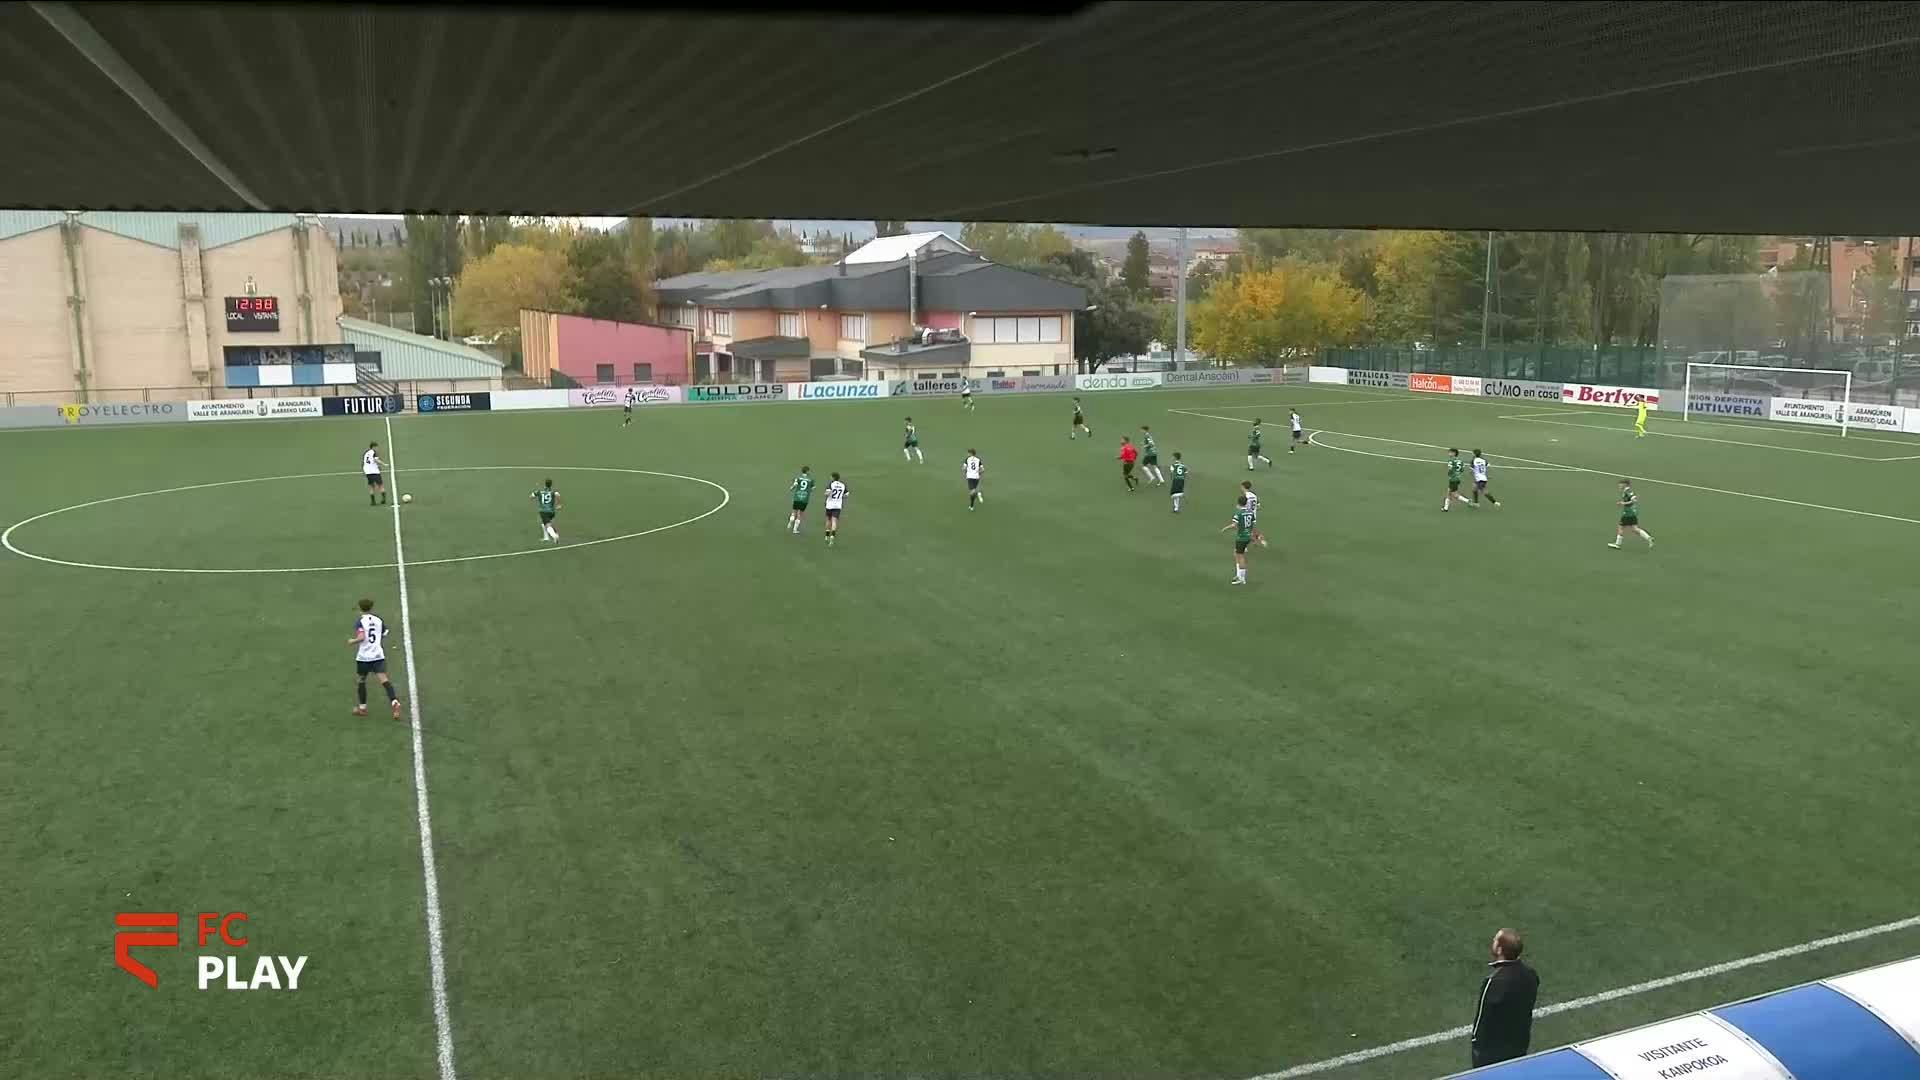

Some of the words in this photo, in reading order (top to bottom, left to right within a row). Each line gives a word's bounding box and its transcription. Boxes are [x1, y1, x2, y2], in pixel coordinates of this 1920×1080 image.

[234, 299, 273, 310] 12:38
[227, 312, 244, 320] LOCAL
[1348, 371, 1390, 379] METALICAS
[913, 380, 958, 391] talleres
[1083, 375, 1127, 389] denda
[1348, 378, 1389, 387] MUTILVA
[692, 384, 783, 396] TOLDOS
[801, 383, 878, 398] Lacunza
[1523, 388, 1535, 397] en
[1538, 389, 1559, 400] casa
[436, 395, 471, 406] SEGUNDA
[1577, 386, 1645, 407] Berlys
[1714, 395, 1763, 405] DEPORTIVA
[57, 403, 173, 417] PROYELECTRO
[1784, 403, 1825, 411] AYUNTAMIENTO
[1856, 408, 1892, 417] ARANGUREN
[1876, 417, 1897, 426] UDALA
[1177, 466, 1183, 475] 6
[800, 480, 808, 491] 9
[541, 493, 552, 504] 19
[831, 489, 843, 499] 27
[368, 627, 376, 644] 5
[1638, 1037, 1708, 1062] VISITANTE
[1658, 1054, 1729, 1079] KANPOKOA
